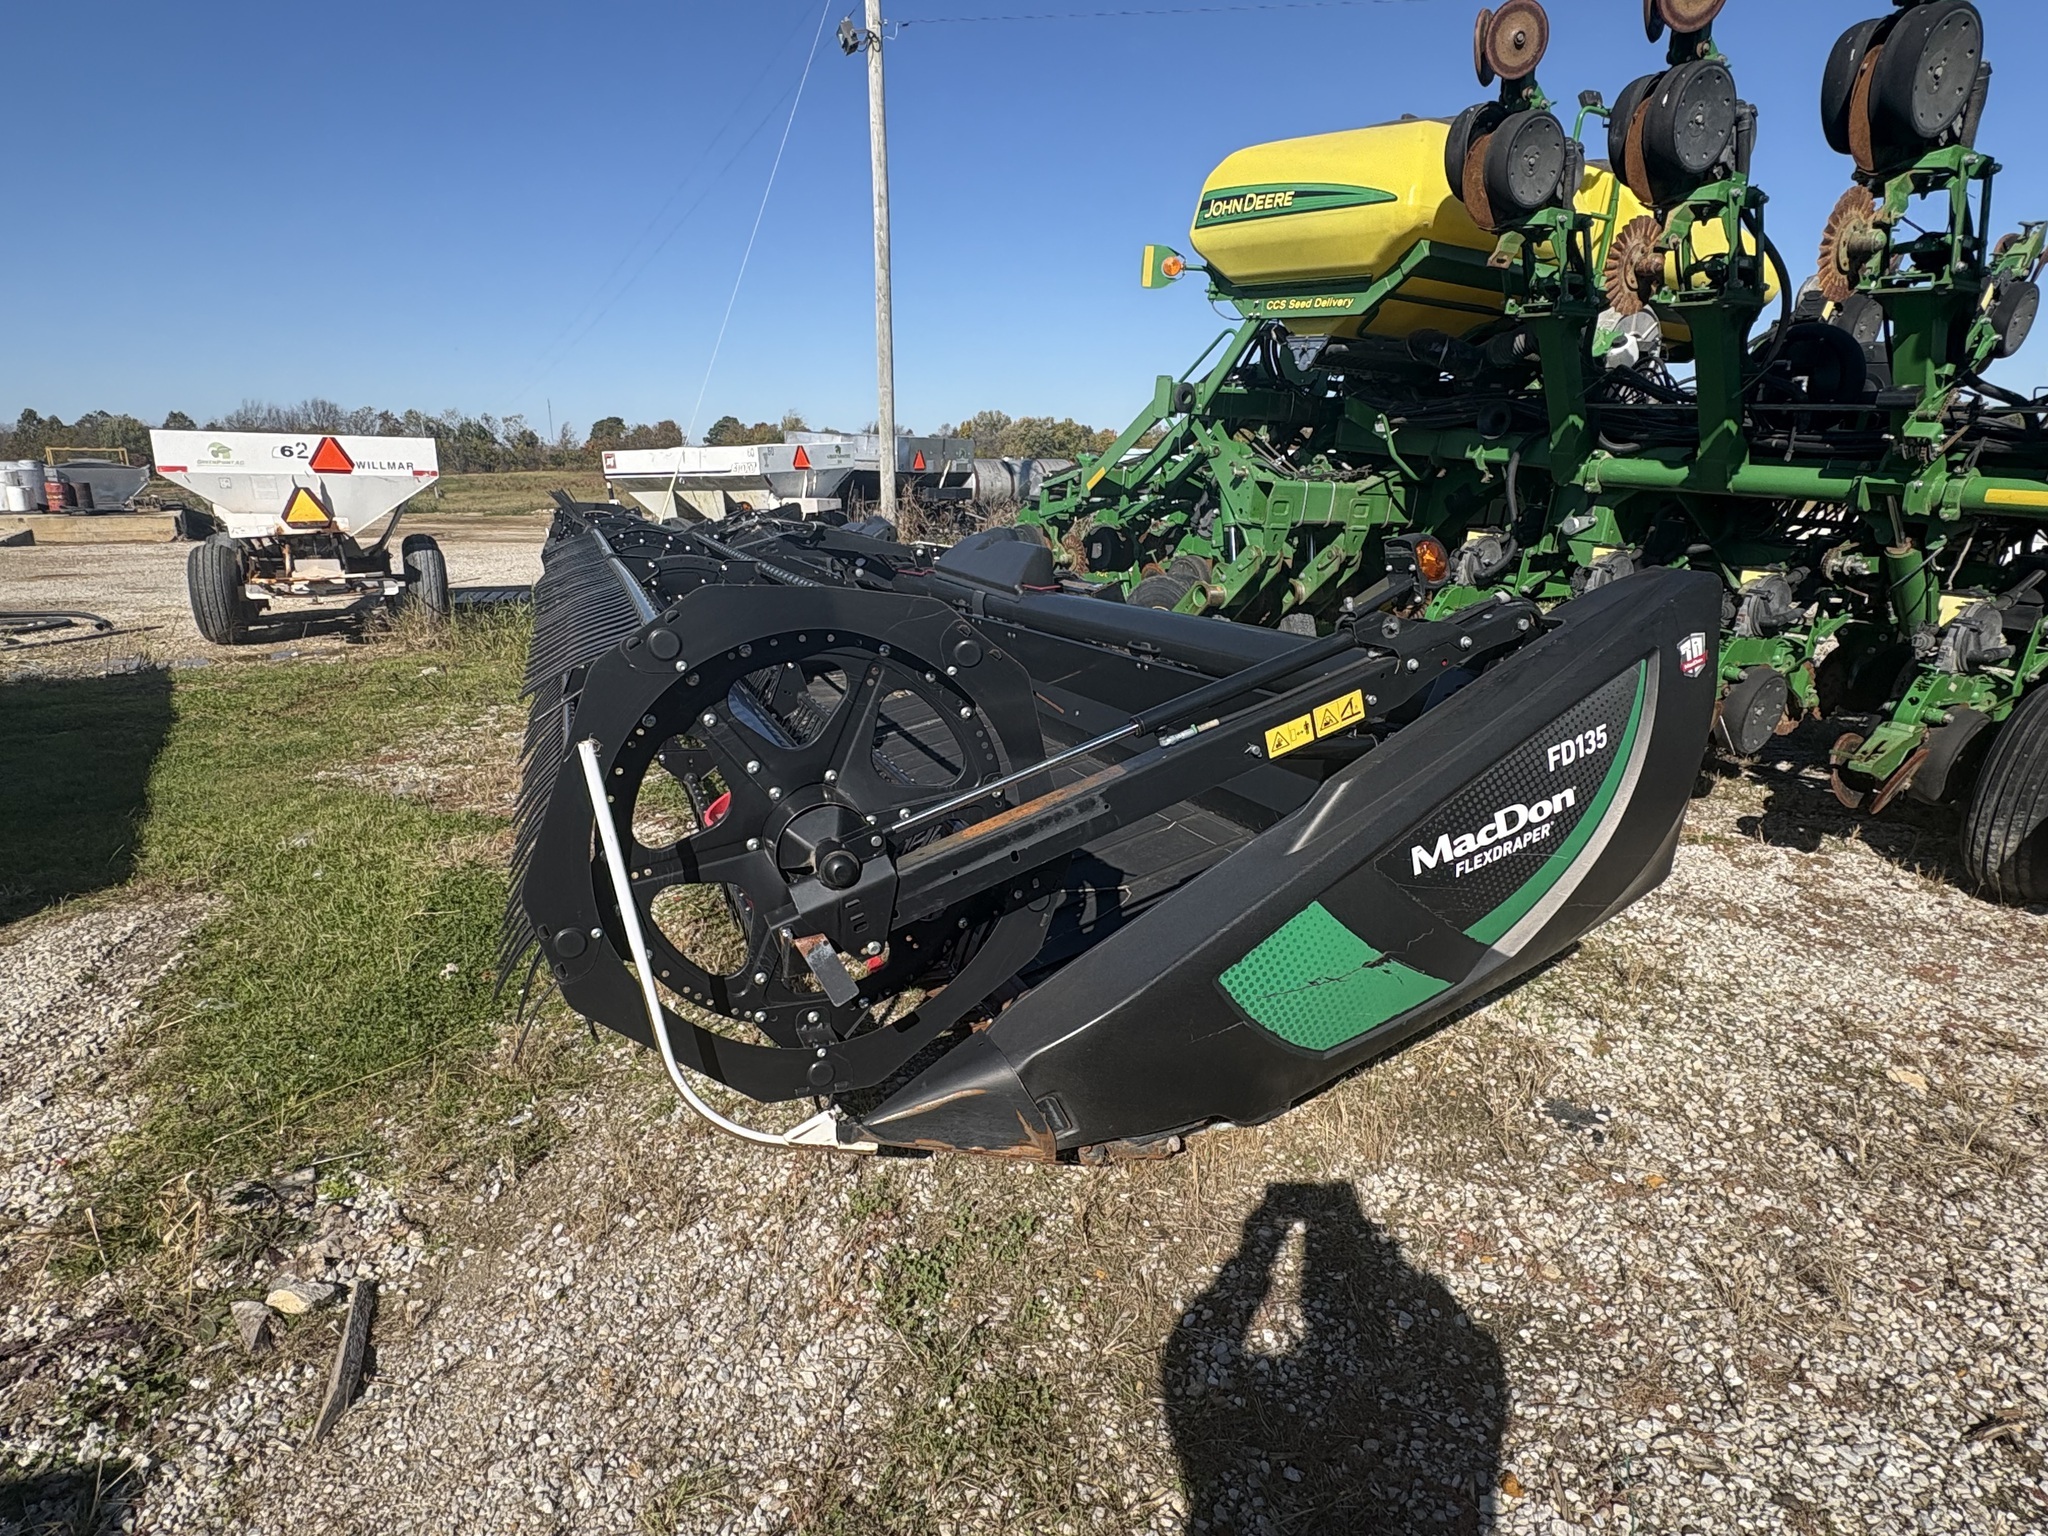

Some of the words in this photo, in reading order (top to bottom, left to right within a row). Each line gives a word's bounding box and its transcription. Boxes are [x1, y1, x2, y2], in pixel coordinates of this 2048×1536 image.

[1204, 198, 1243, 218] JOHN
[1243, 190, 1295, 212] DEERE
[1266, 299, 1286, 311] CCS
[1288, 298, 1312, 310] Seed
[1314, 296, 1354, 309] Delivery
[280, 442, 309, 459] 62
[355, 461, 414, 470] WILLMAR
[1547, 723, 1608, 773] FD135
[1411, 786, 1577, 877] MacDon
[1455, 821, 1554, 879] FLEXDRAPER
